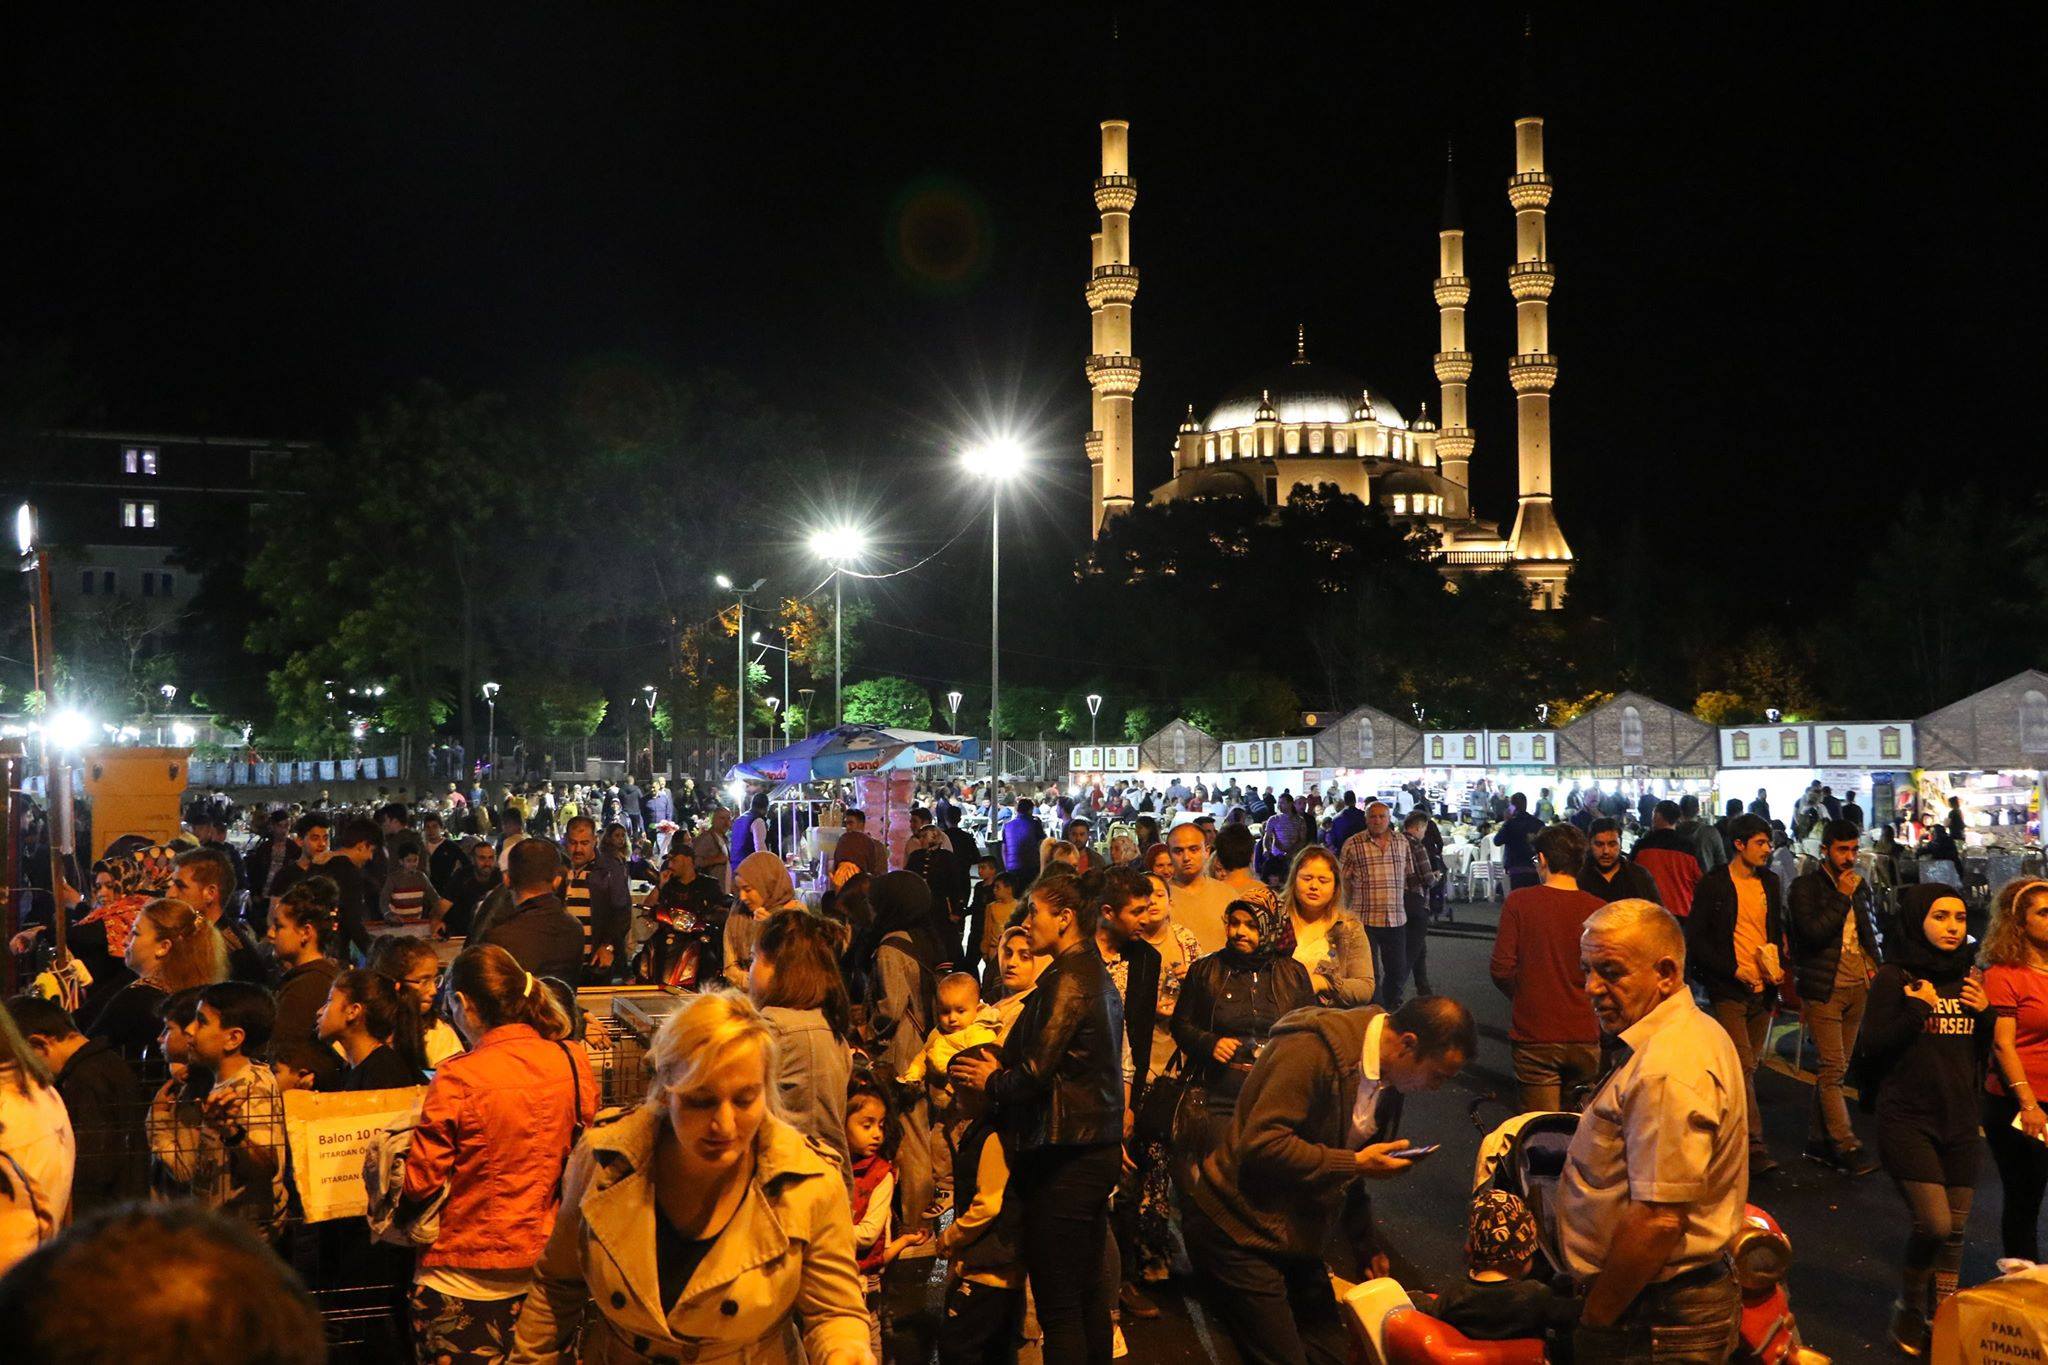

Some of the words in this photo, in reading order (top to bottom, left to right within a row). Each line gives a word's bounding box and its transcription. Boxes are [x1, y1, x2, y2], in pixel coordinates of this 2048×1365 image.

[319, 1133, 353, 1145] Balon
[356, 1129, 370, 1140] 10
[1992, 1321, 2023, 1338] PARA
[1980, 1339, 2041, 1361] ATMADAN
